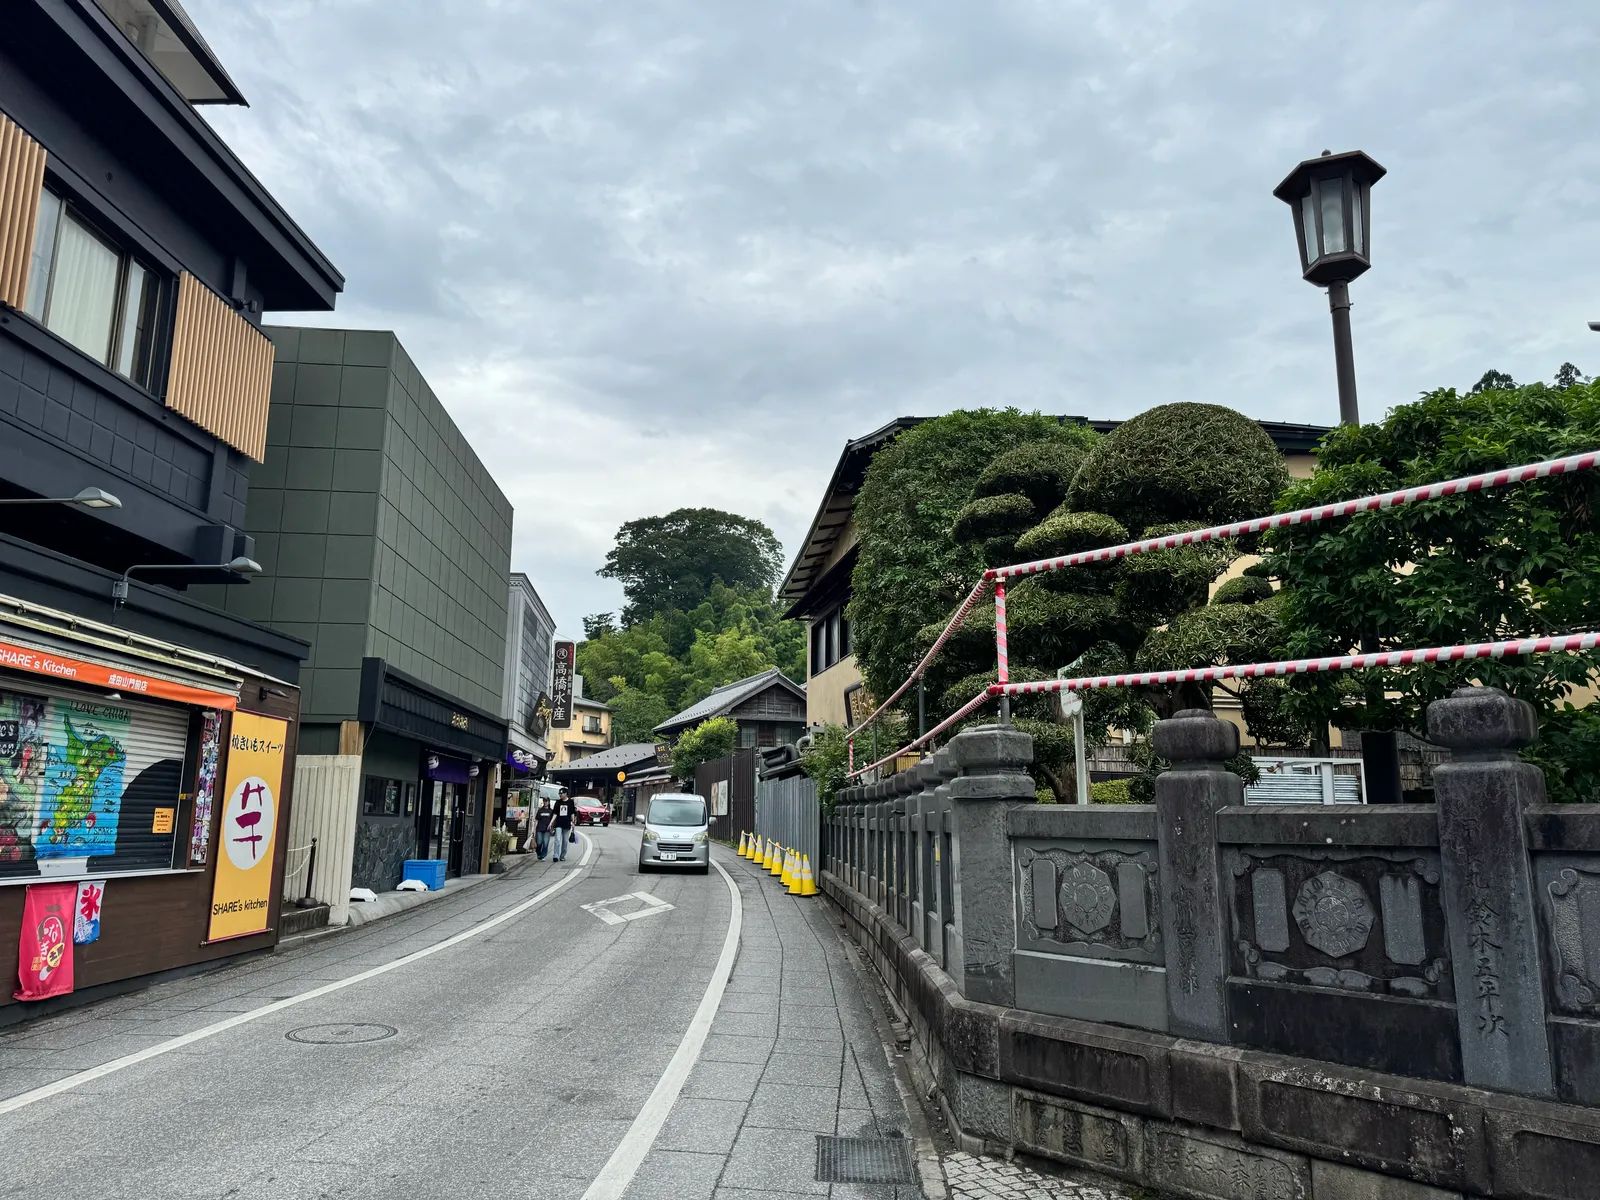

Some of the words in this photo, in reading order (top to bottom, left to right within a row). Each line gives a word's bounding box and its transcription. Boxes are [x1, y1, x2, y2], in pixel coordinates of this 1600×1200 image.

[42, 659, 76, 676] Kitchen
[108, 674, 148, 691] 成田山門前店
[553, 662, 567, 720] 高橋水産
[231, 734, 283, 754] 焼きいもスイーツ
[212, 899, 243, 916] SHARE's
[244, 898, 268, 911] kitchen
